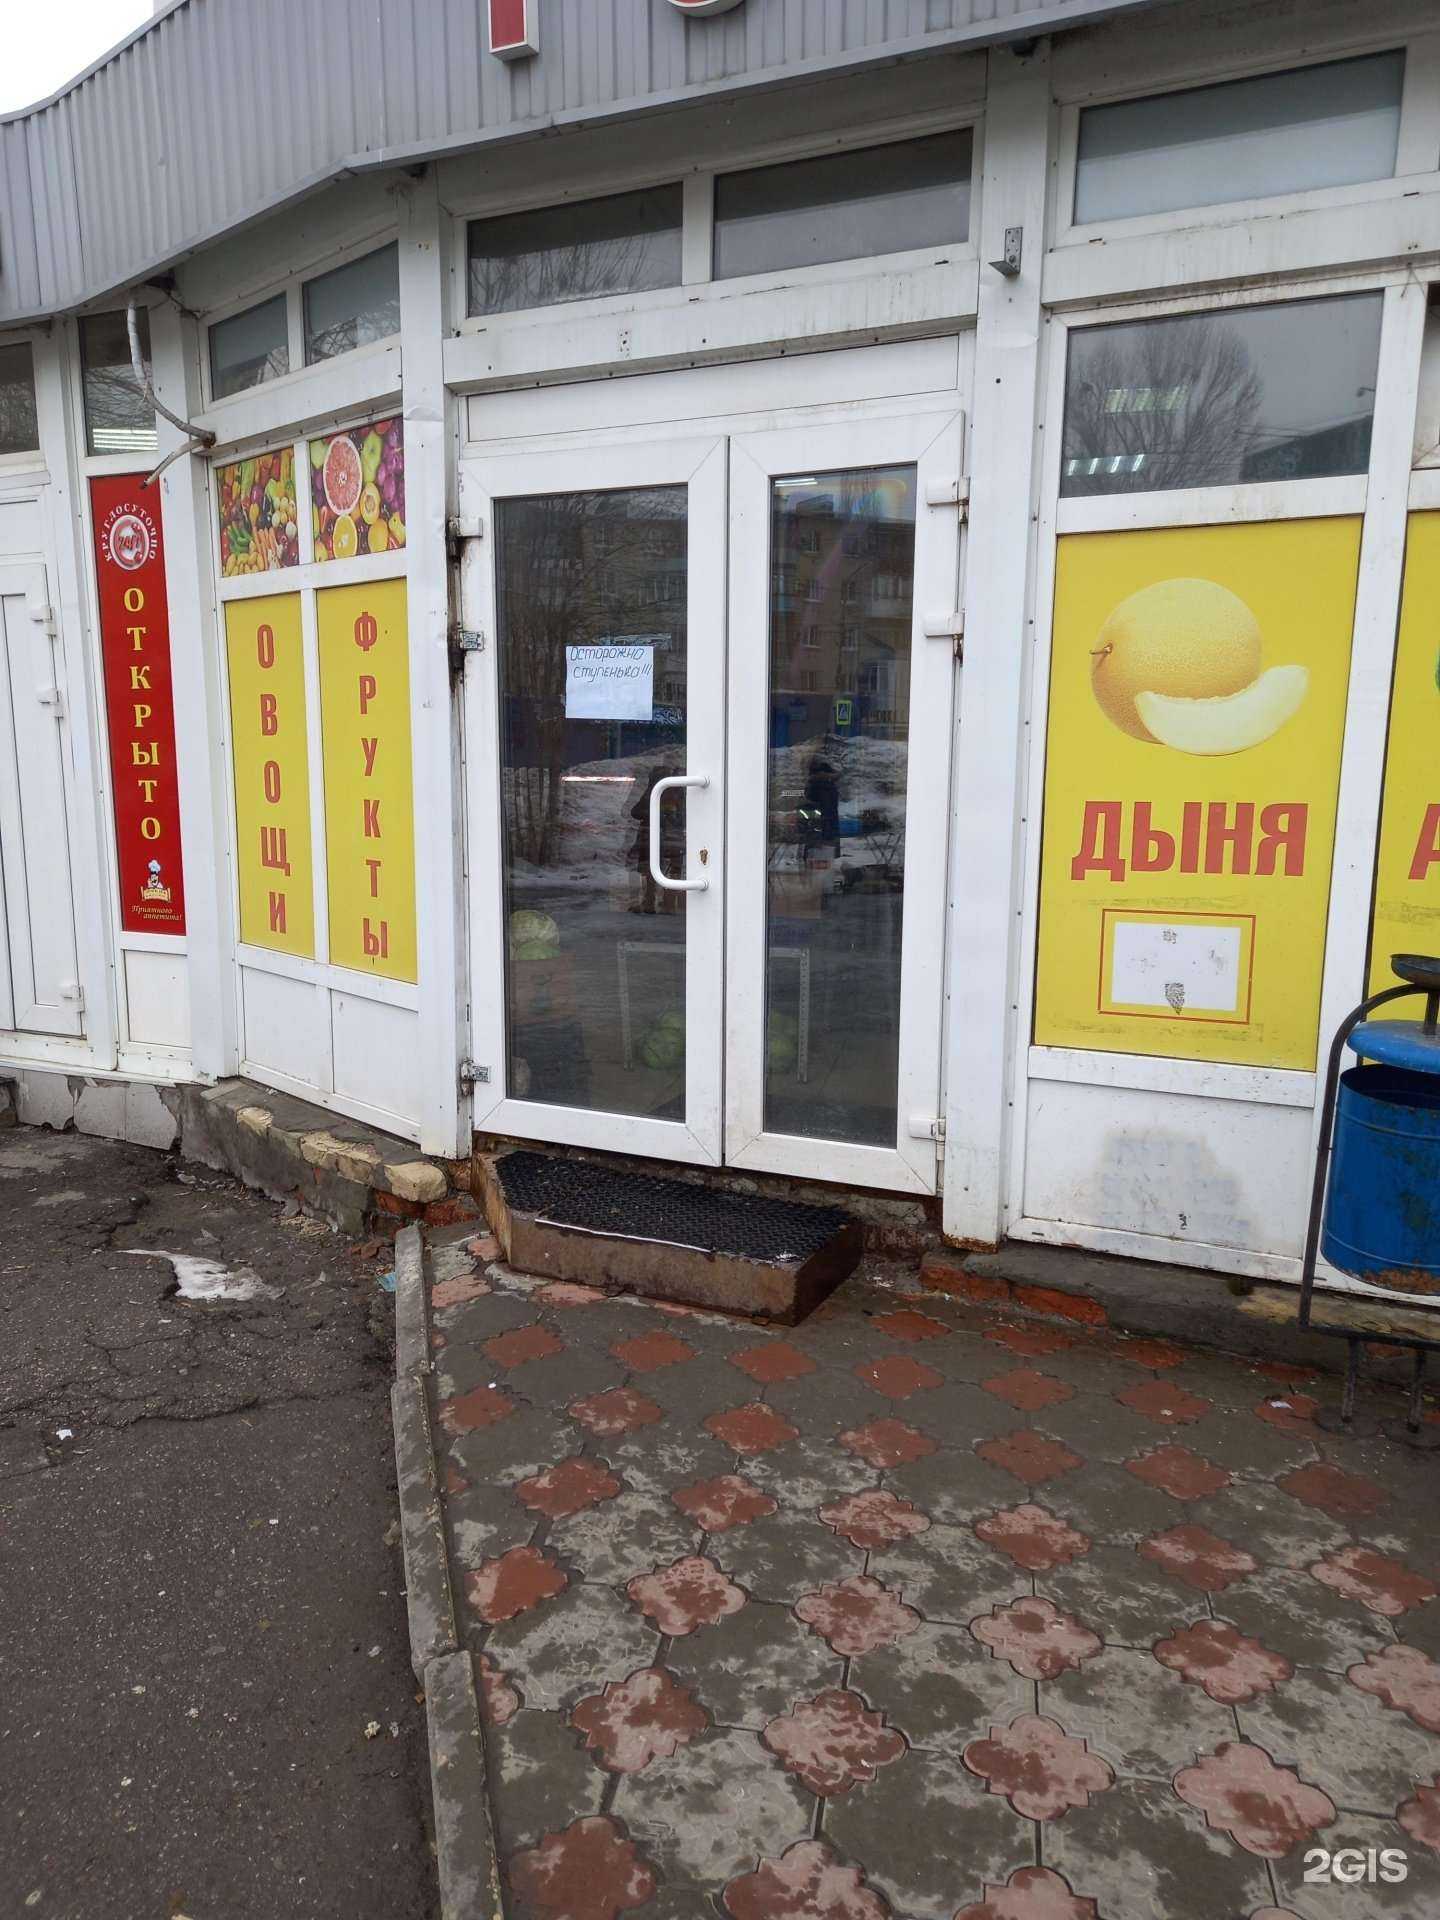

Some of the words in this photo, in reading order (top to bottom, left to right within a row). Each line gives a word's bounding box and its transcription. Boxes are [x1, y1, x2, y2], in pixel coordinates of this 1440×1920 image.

[101, 503, 158, 562] КРУГЛОСУТОЧНО
[123, 587, 160, 840] ОТКРЫТО
[256, 623, 291, 935] ОВОЩИ
[353, 611, 389, 959] ФРУКТЫ
[1070, 800, 1309, 882] ДЫНЯ
